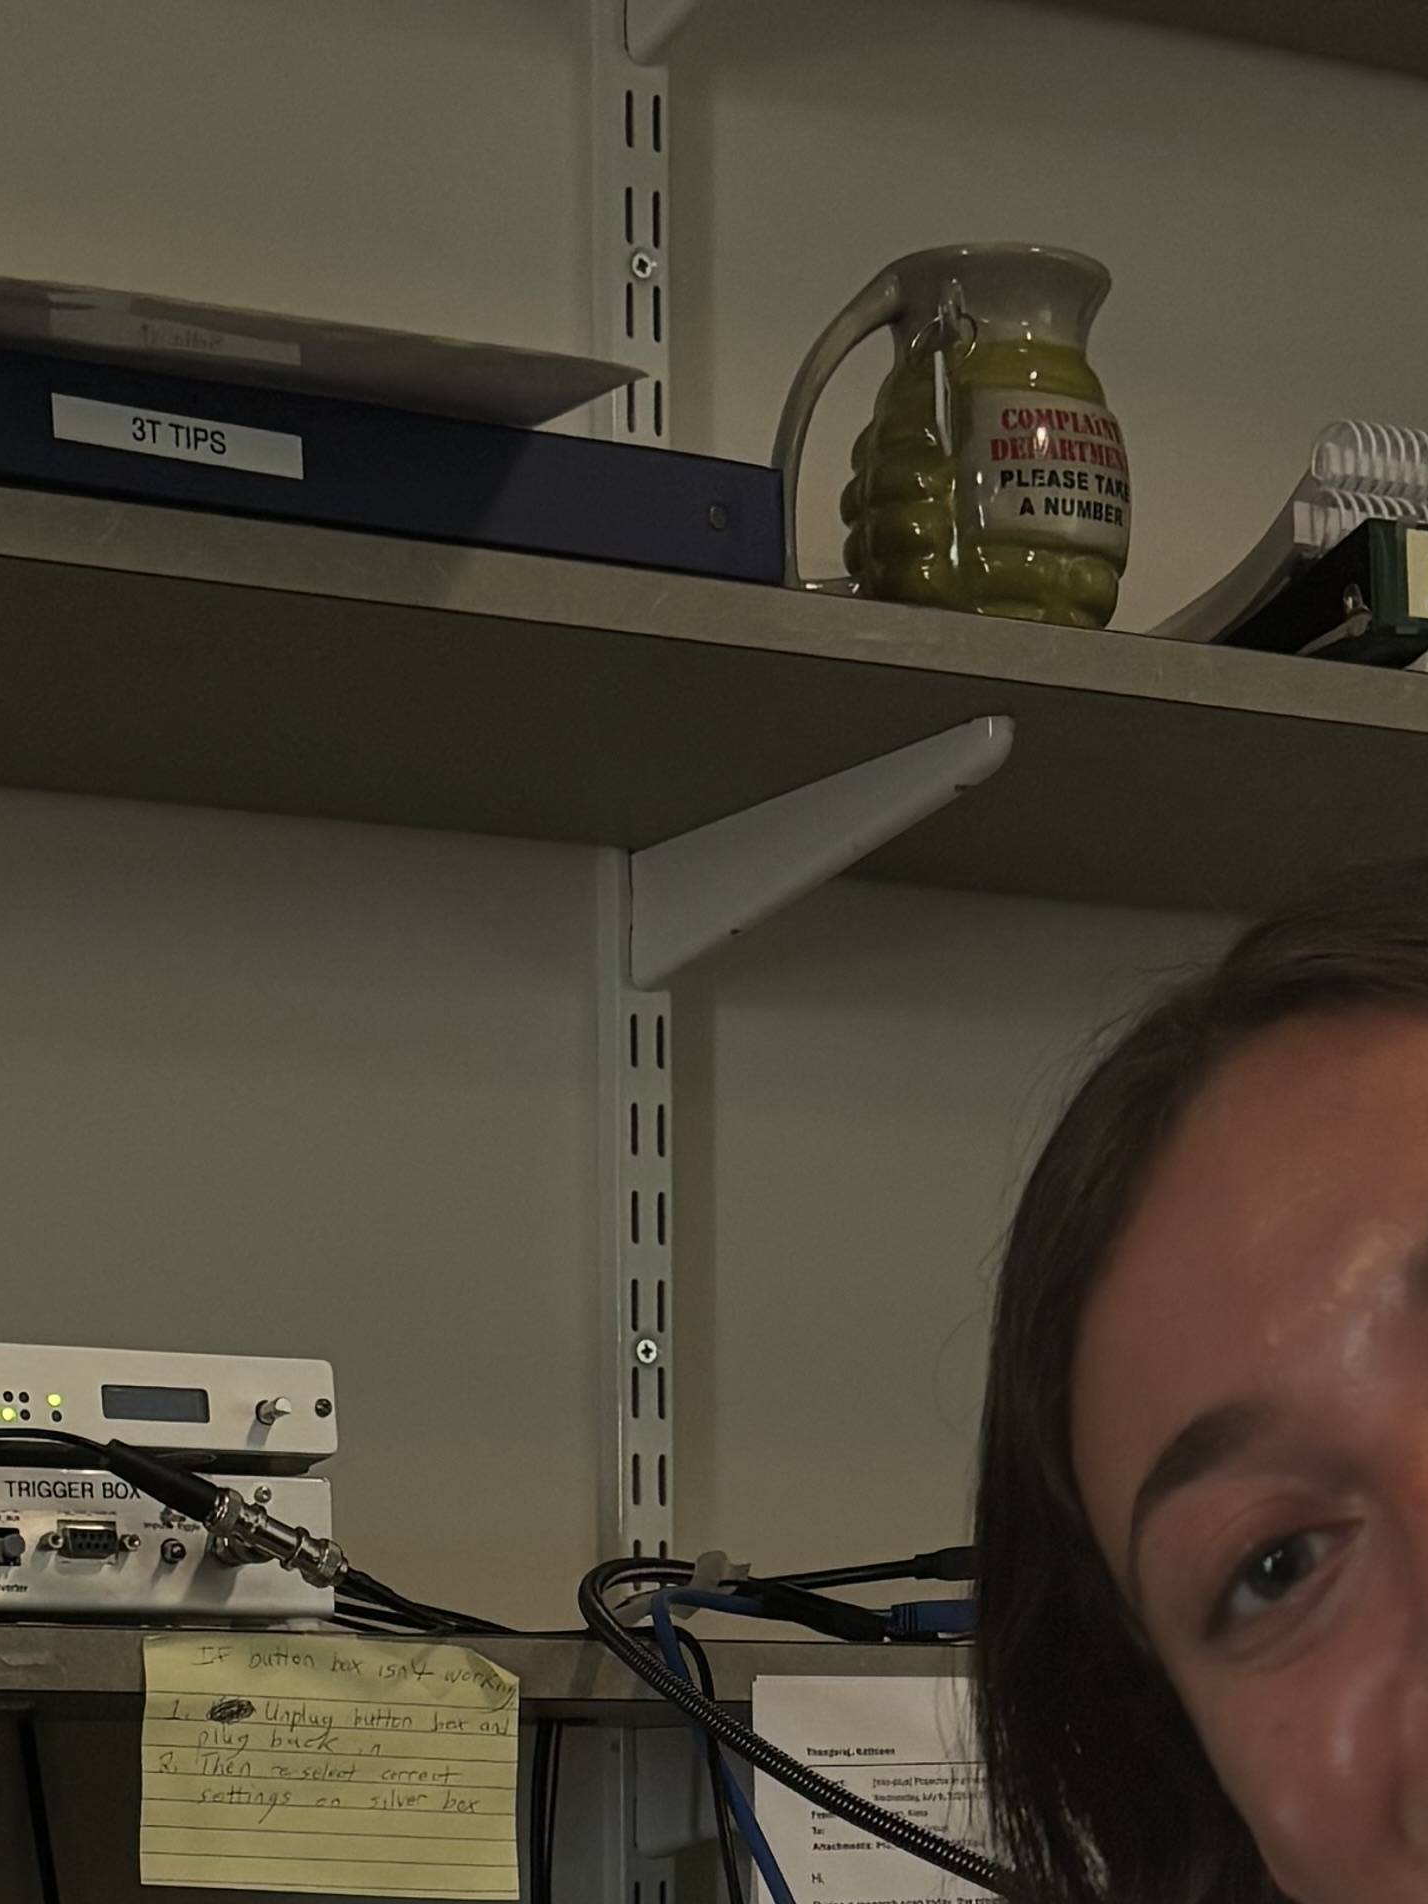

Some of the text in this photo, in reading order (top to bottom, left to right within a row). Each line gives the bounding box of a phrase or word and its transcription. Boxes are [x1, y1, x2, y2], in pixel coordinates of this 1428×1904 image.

[132, 417, 227, 454] 3T TIPS
[1000, 469, 1130, 503] PLEASE TAKE
[1020, 497, 1123, 527] A NUMBER
[4, 1480, 141, 1500] TRIGGER BOX
[265, 1701, 332, 1730] Unplug
[354, 1708, 412, 1727] button
[479, 1719, 509, 1735] and
[272, 1730, 338, 1752] back
[201, 1752, 251, 1776] Then
[381, 1766, 461, 1785] correct
[198, 1785, 292, 1824] settings
[370, 1789, 427, 1810] silver
